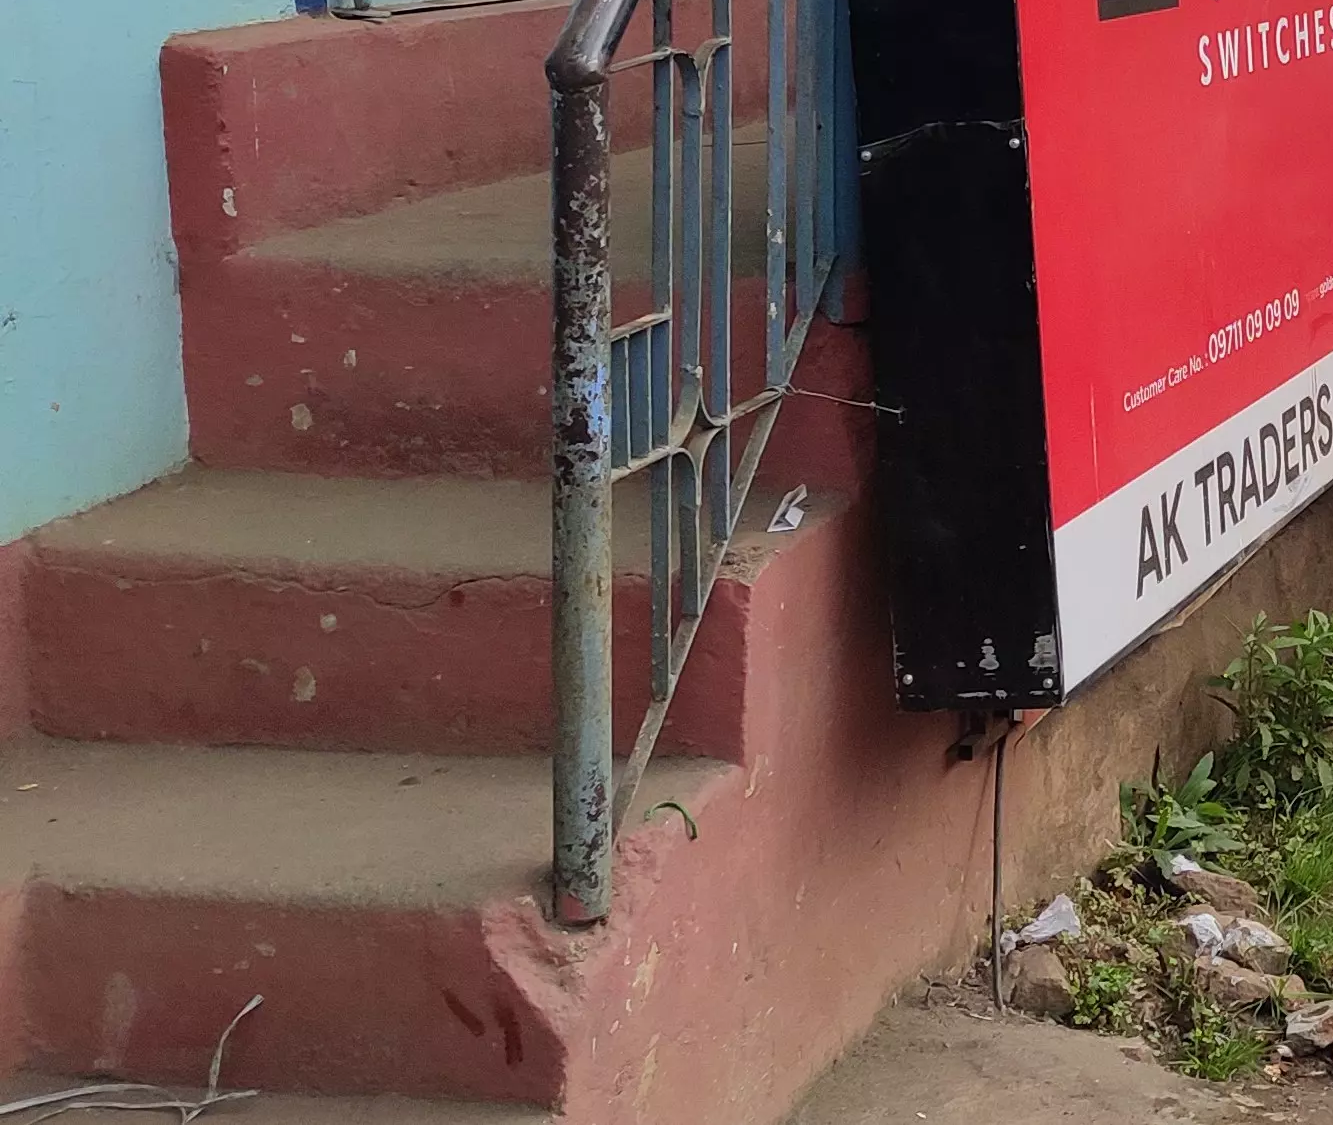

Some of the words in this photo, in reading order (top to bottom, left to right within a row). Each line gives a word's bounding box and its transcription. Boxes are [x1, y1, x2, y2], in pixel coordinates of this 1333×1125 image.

[1123, 377, 1167, 412] Customer
[1168, 364, 1188, 387] Care
[1208, 322, 1243, 364] 09711
[1246, 312, 1263, 343] 09
[1265, 300, 1281, 332] 09
[1284, 288, 1299, 319] 09
[1136, 480, 1188, 601] AK
[1194, 383, 1333, 547] TRADERS
